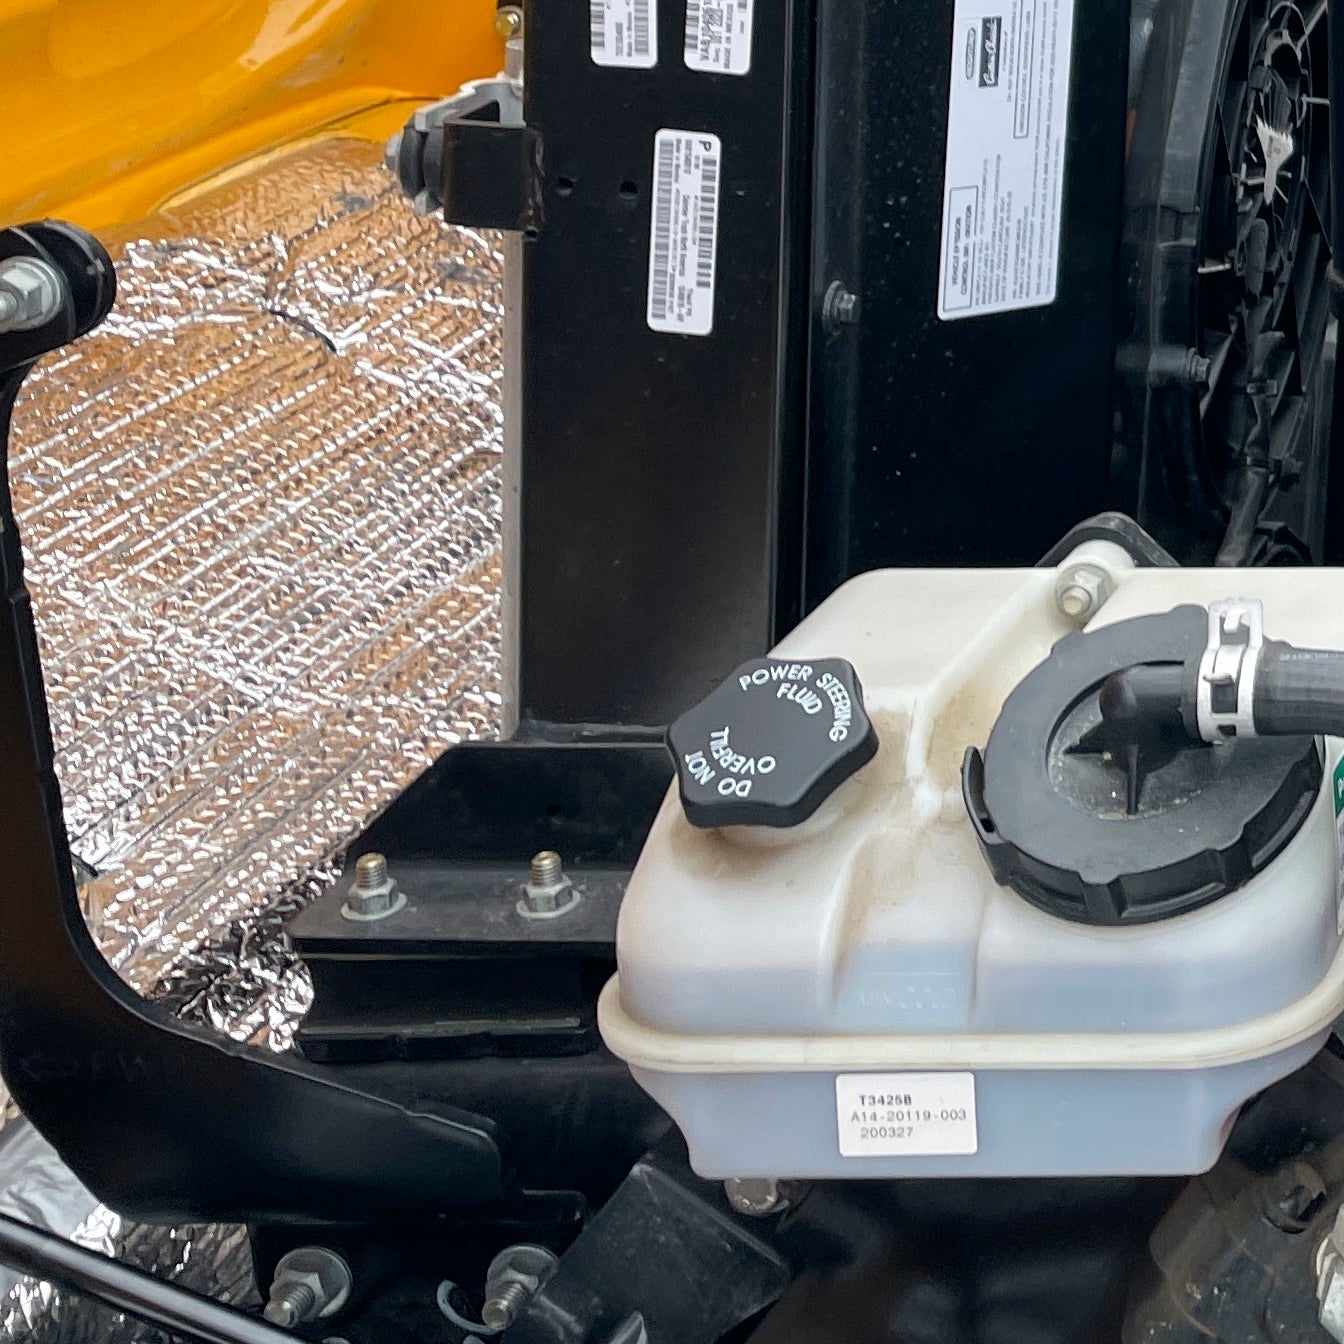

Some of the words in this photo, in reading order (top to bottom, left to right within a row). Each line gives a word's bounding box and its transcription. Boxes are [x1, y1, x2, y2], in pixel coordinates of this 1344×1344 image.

[738, 664, 813, 691] POWER
[815, 672, 852, 742] STEERING
[776, 682, 823, 715] FLUID
[709, 725, 777, 776] OVERFILL
[684, 750, 716, 786] NOT
[717, 776, 752, 798] DO
[850, 1108, 967, 1123] A14-20119-003
[860, 1126, 914, 1139] 200327
